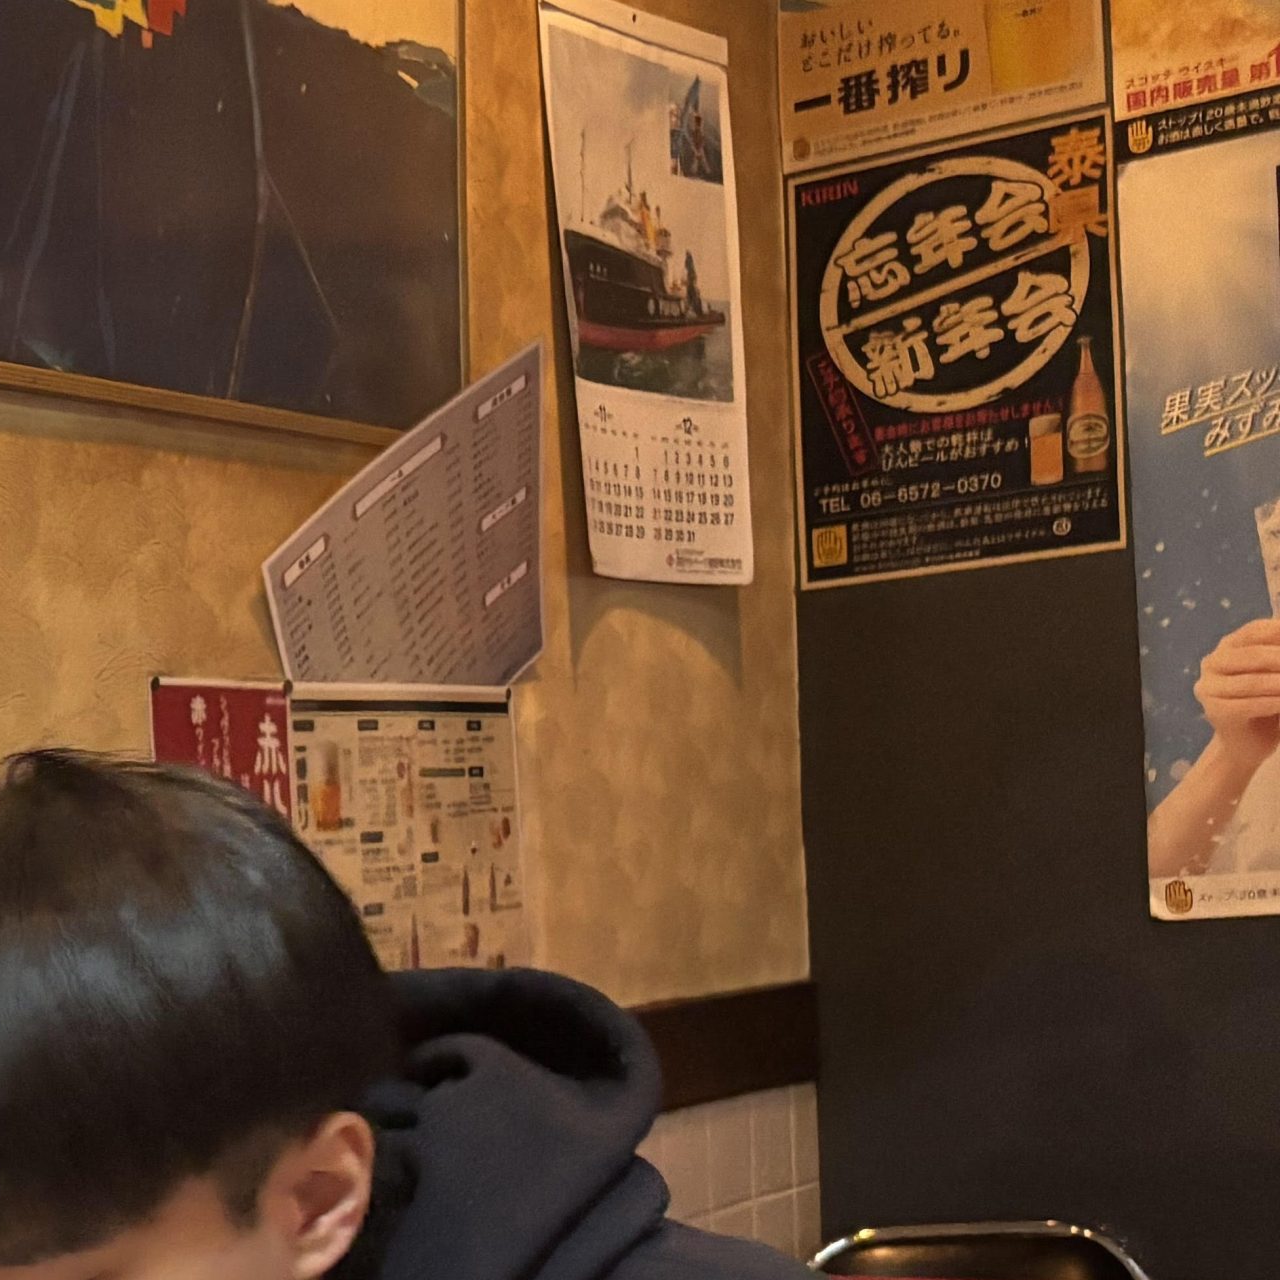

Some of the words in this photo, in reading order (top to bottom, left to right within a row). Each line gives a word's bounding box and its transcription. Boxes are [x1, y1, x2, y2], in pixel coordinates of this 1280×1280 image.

[800, 179, 860, 208] KIRIN
[837, 180, 1051, 309] 忘年会
[862, 268, 1079, 398] 新年会
[599, 405, 607, 422] 11
[683, 417, 692, 435] 12
[819, 497, 851, 514] TEL
